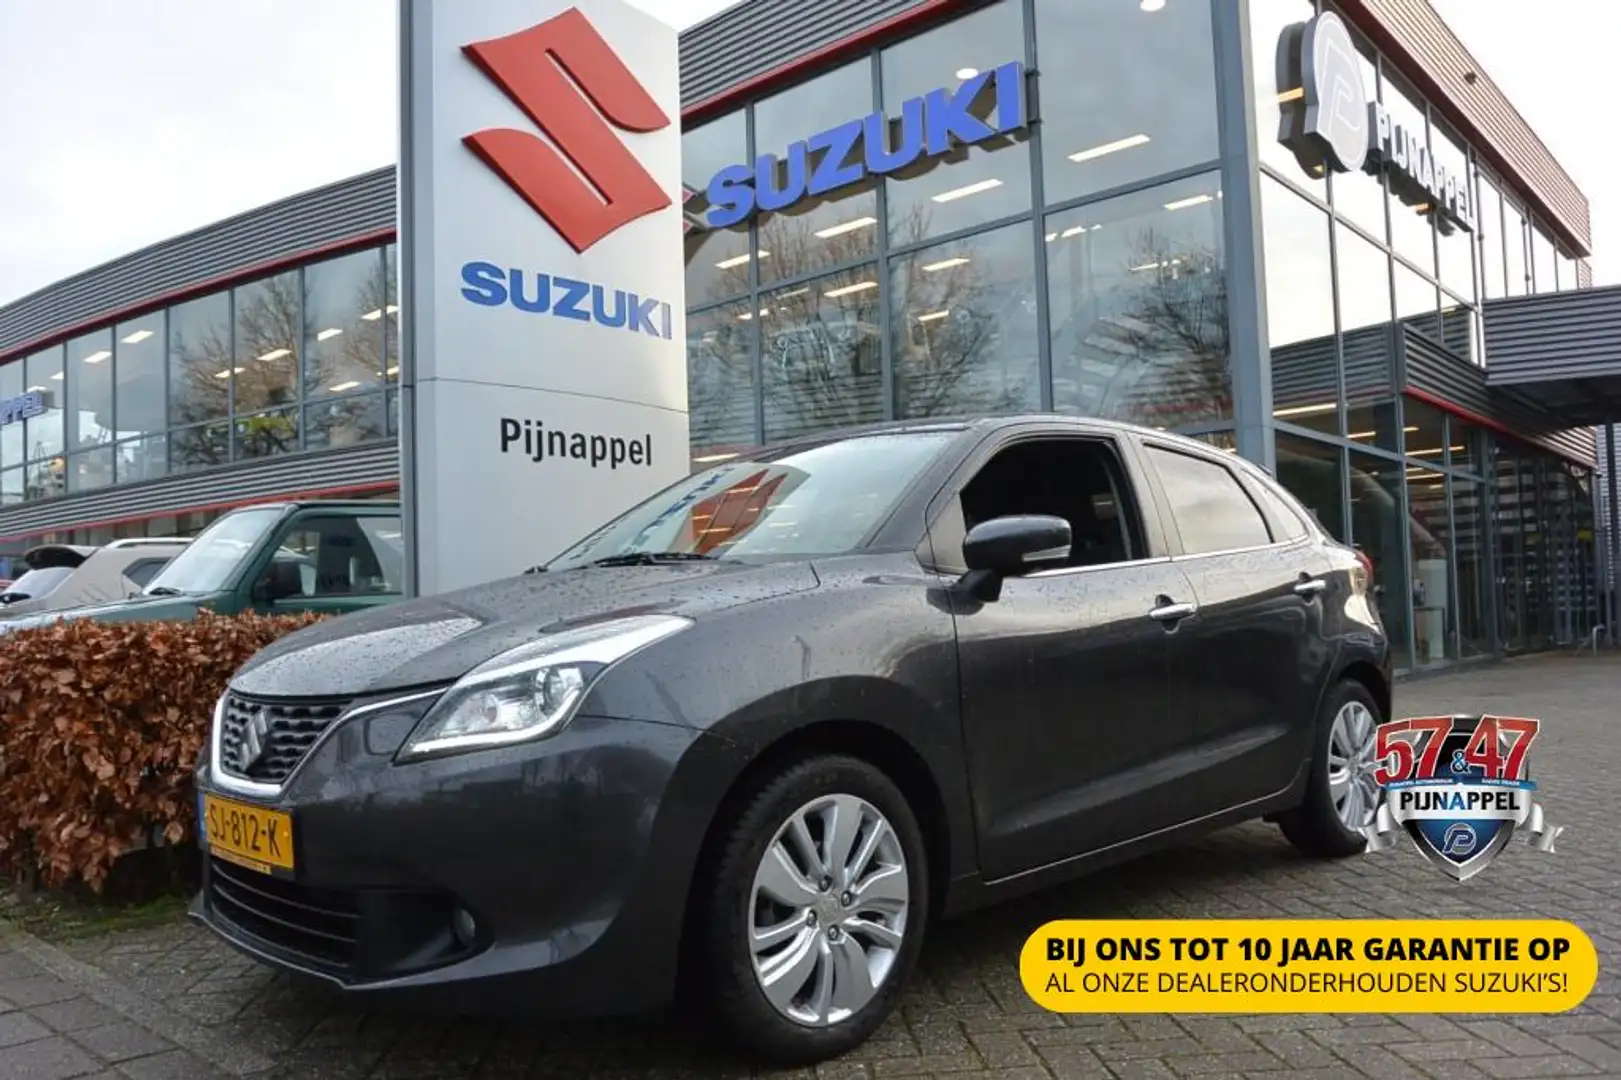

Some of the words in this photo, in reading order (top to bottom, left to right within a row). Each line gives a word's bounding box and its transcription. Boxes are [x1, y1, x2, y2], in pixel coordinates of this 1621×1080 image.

[705, 60, 1028, 228] SUZUKI
[1371, 100, 1476, 232] PIJNAPPEL
[461, 261, 672, 340] SUZUKI
[501, 417, 652, 469] Pijnappel
[209, 803, 282, 858] SJ-812-K
